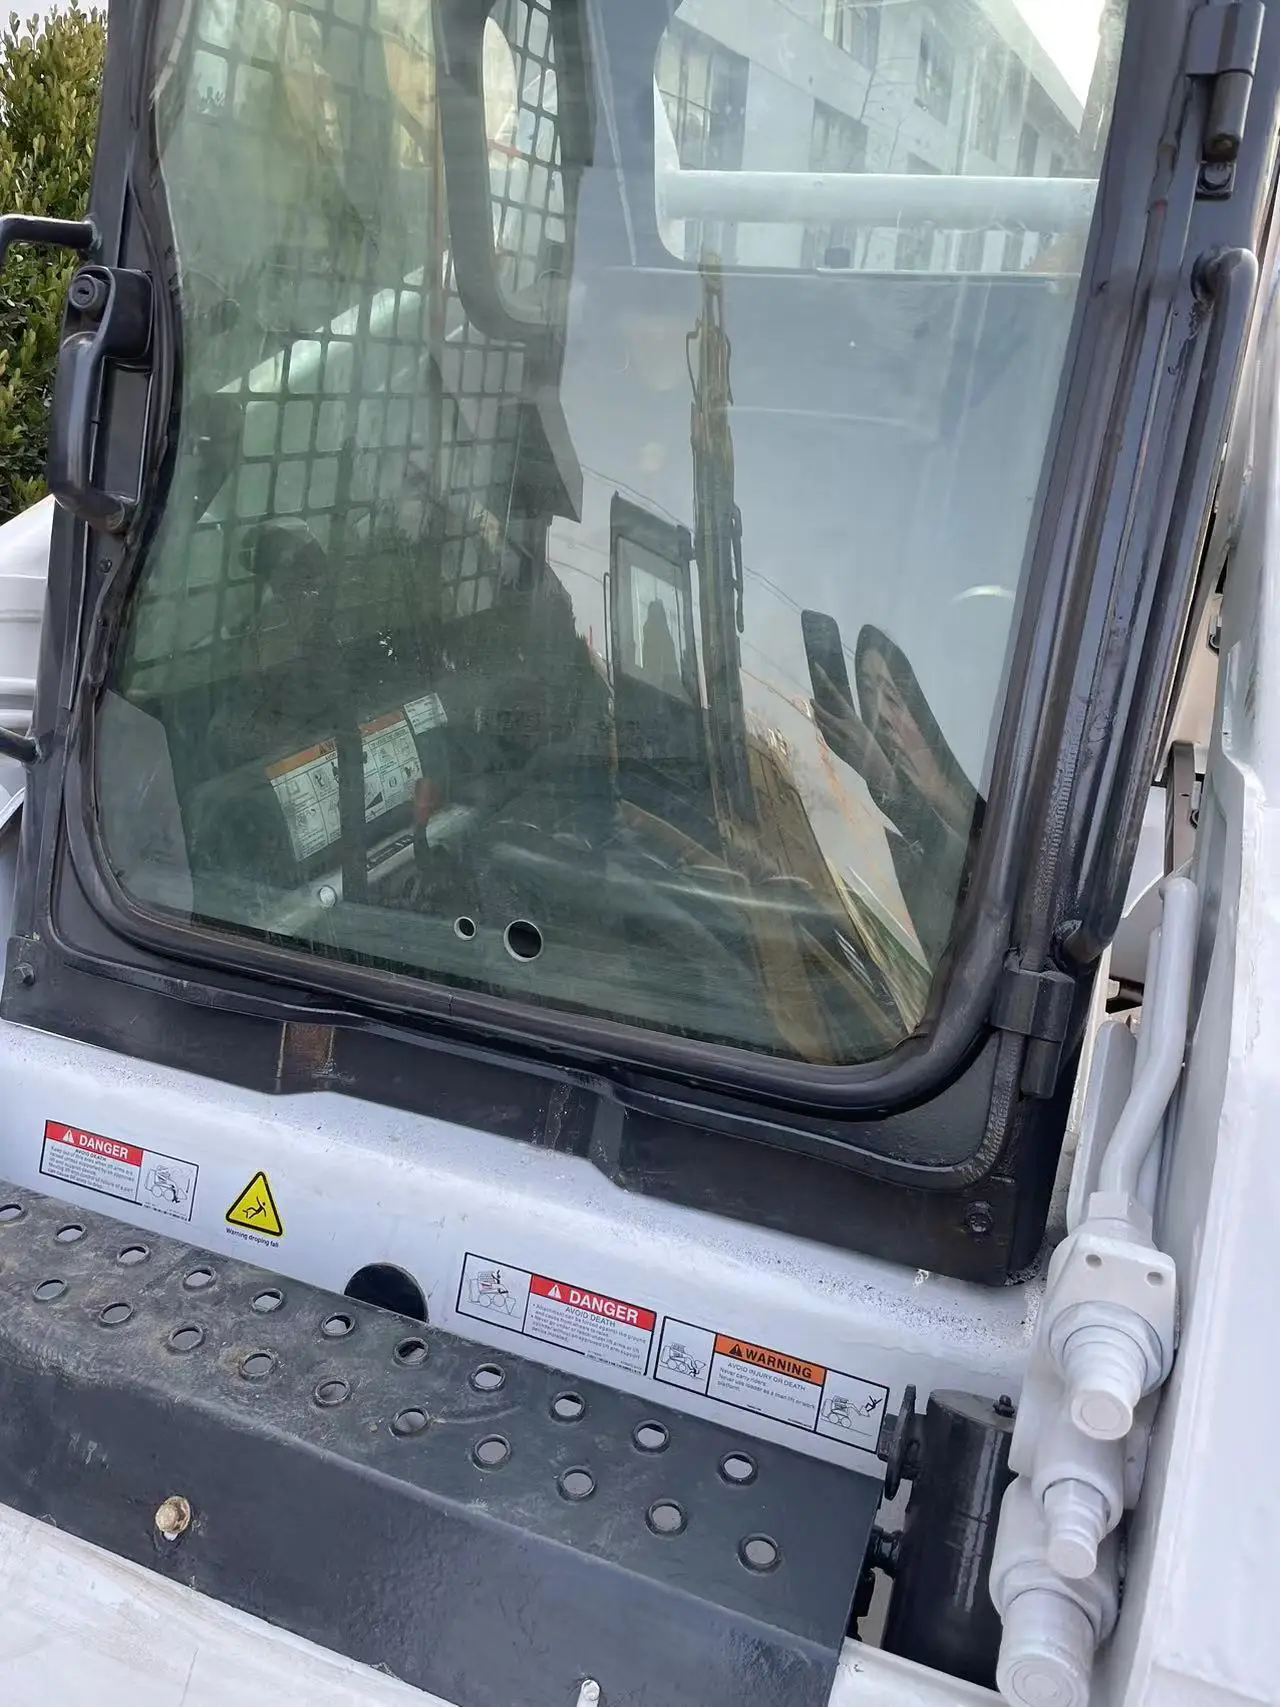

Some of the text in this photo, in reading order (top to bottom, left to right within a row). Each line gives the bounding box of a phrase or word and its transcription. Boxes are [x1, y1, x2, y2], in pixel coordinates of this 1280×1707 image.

[79, 1134, 128, 1159] DANGER
[225, 1227, 279, 1248] Warning droping fall
[565, 1306, 615, 1327] AVOID DEATH
[569, 1290, 638, 1323] DANGER
[727, 1361, 747, 1373] AVOID
[783, 1379, 805, 1391] DEATH
[745, 1348, 812, 1378] WARNING
